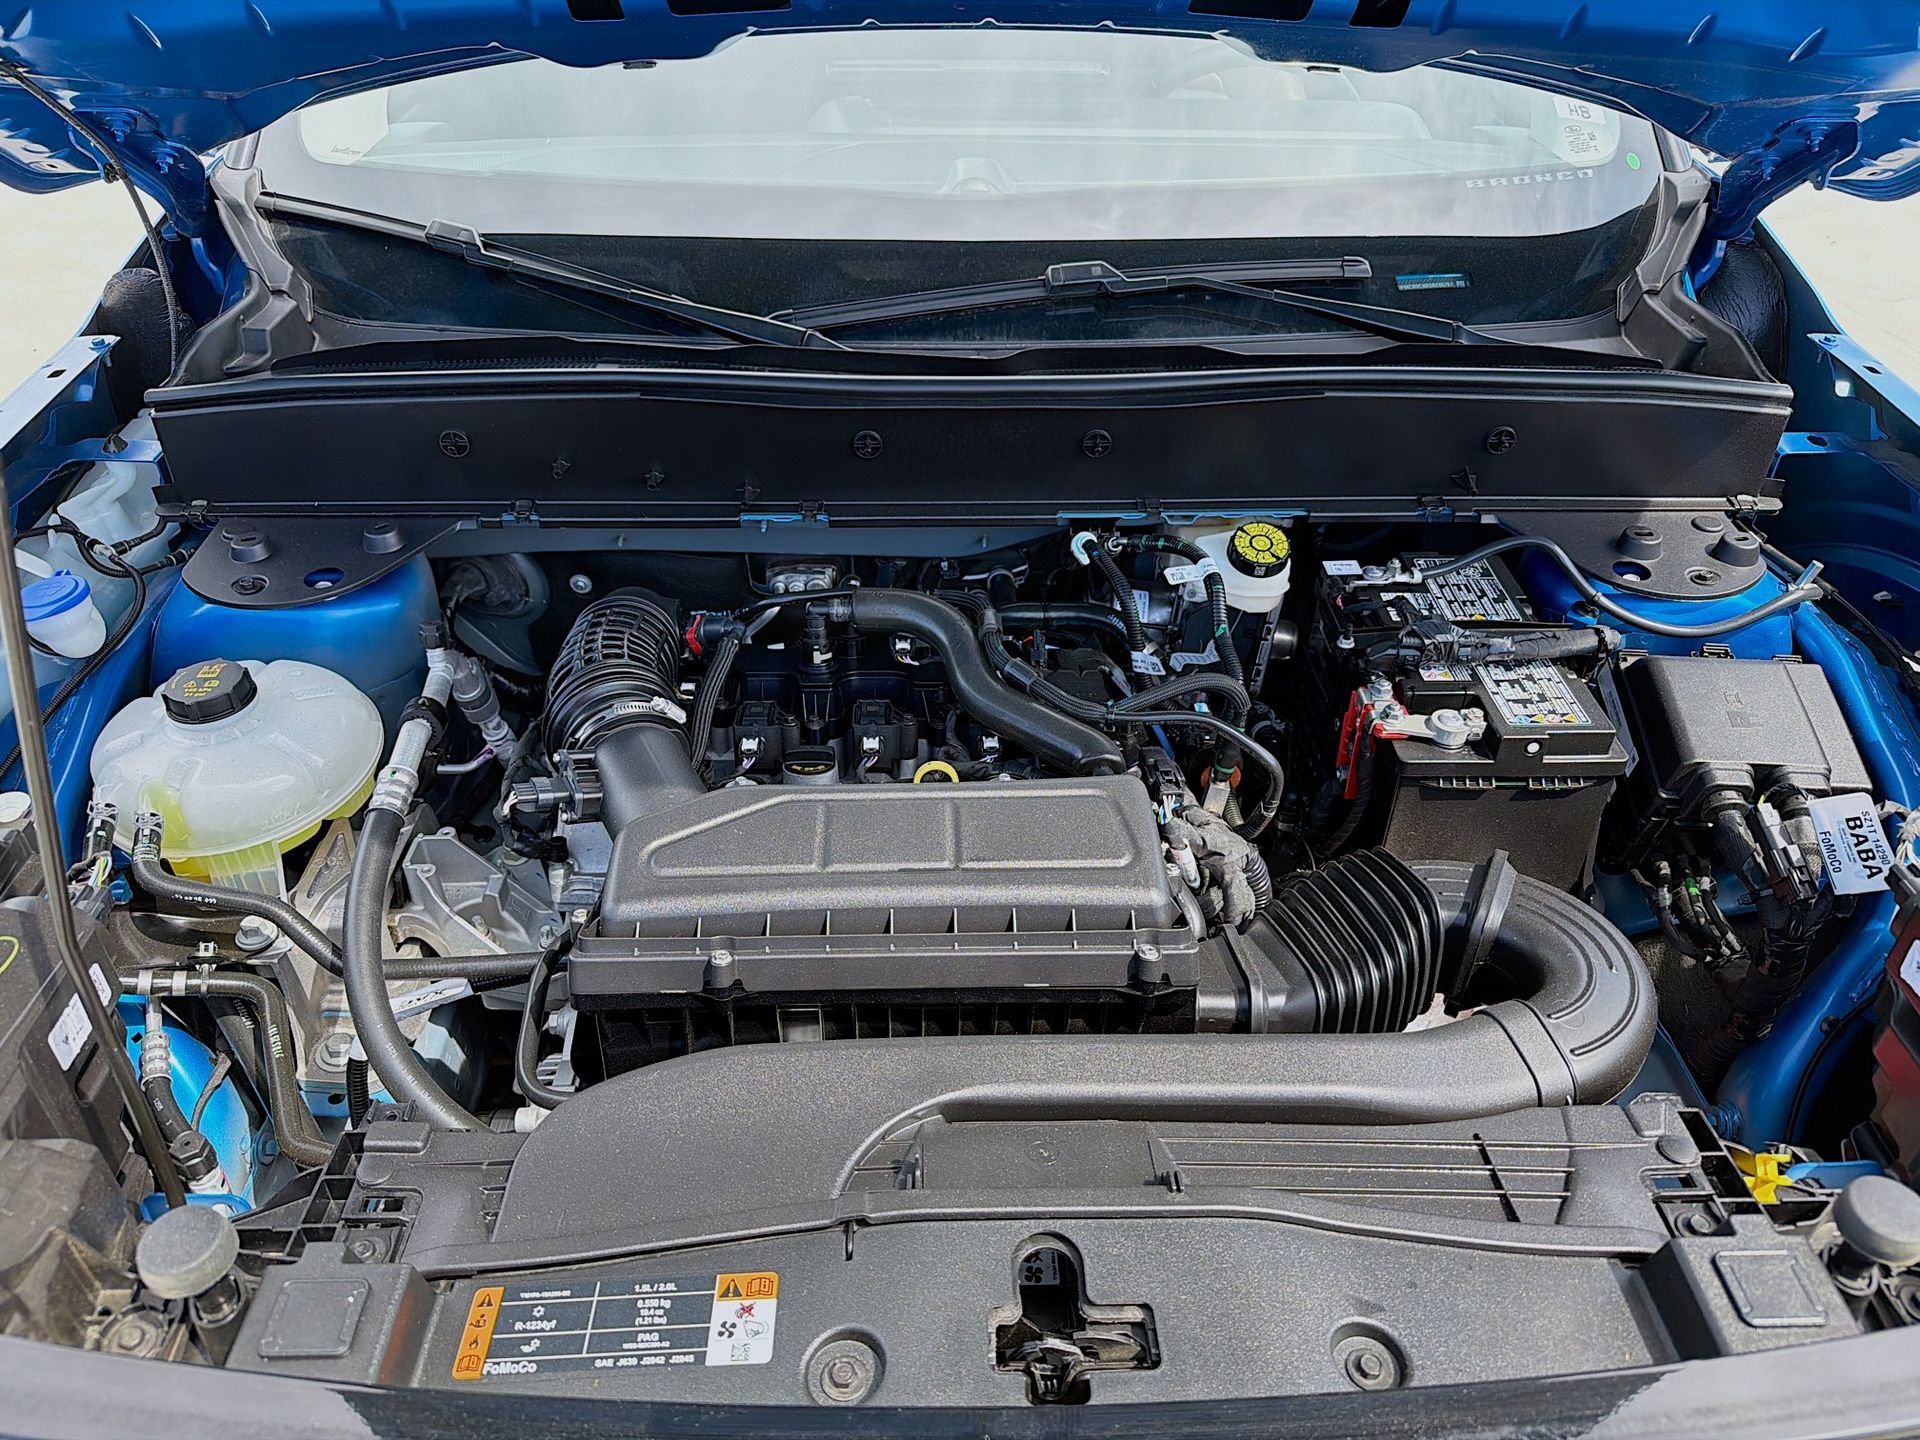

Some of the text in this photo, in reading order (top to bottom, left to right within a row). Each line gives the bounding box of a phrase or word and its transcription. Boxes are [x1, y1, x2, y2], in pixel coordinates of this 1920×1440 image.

[1465, 169, 1594, 188] BRONCO
[1819, 831, 1842, 873] FoMoCo
[1845, 816, 1884, 880] BABA
[1872, 838, 1891, 866] 14290
[636, 1298, 671, 1309] 0.550 kg
[514, 1320, 557, 1331] R-1234yf
[637, 1332, 659, 1342] PAG
[482, 1361, 537, 1376] FoMoCo
[594, 1358, 614, 1368] SAE
